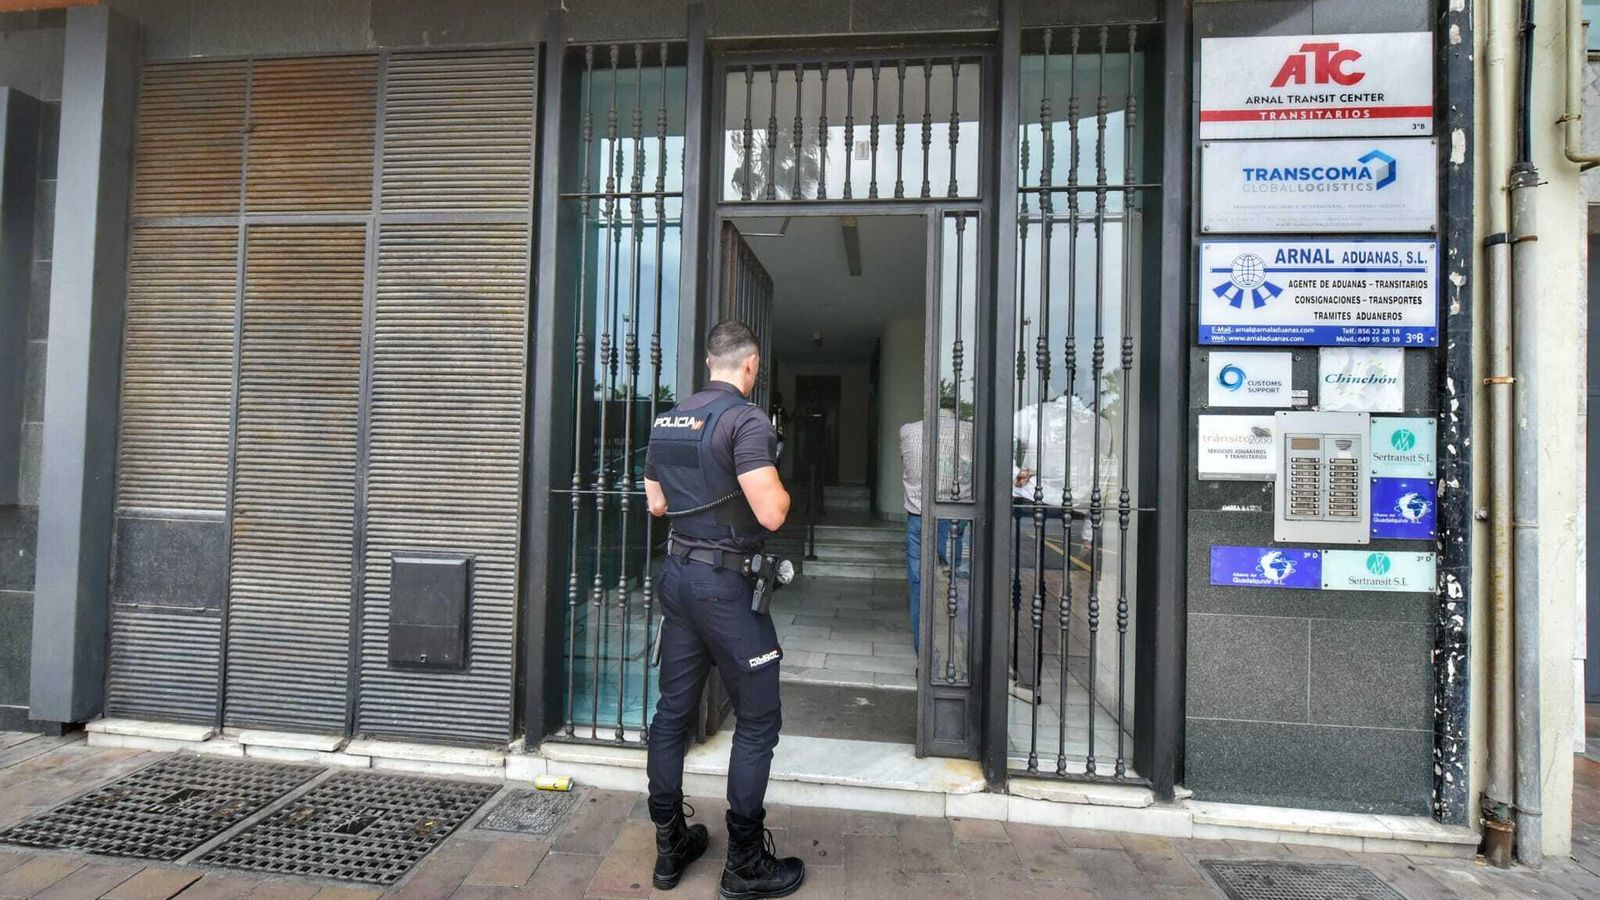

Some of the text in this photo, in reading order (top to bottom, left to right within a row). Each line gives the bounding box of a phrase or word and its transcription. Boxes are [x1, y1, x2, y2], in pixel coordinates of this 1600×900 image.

[1270, 42, 1366, 87] ATC
[1245, 92, 1385, 105] ARNAL TRANSIT CENTER
[1259, 109, 1371, 121] TRANSITARIOS
[1243, 166, 1373, 181] TRANSCOMA
[1274, 248, 1428, 266] ARNAL ADUANAS, S.L.
[1288, 280, 1317, 289] AGENTE
[1320, 280, 1330, 289] DE
[1332, 279, 1367, 289] ADUANAS
[1375, 279, 1428, 289] TRANSITARIOS
[1295, 296, 1361, 305] CONSIGNACIONES
[1369, 296, 1423, 305] TRANSPORTES
[1314, 312, 1403, 321] TRAMITES ADUANEROS
[1325, 372, 1397, 386] Chinchón
[1373, 452, 1417, 463] Sertransit
[1348, 576, 1391, 586] Sertransit
